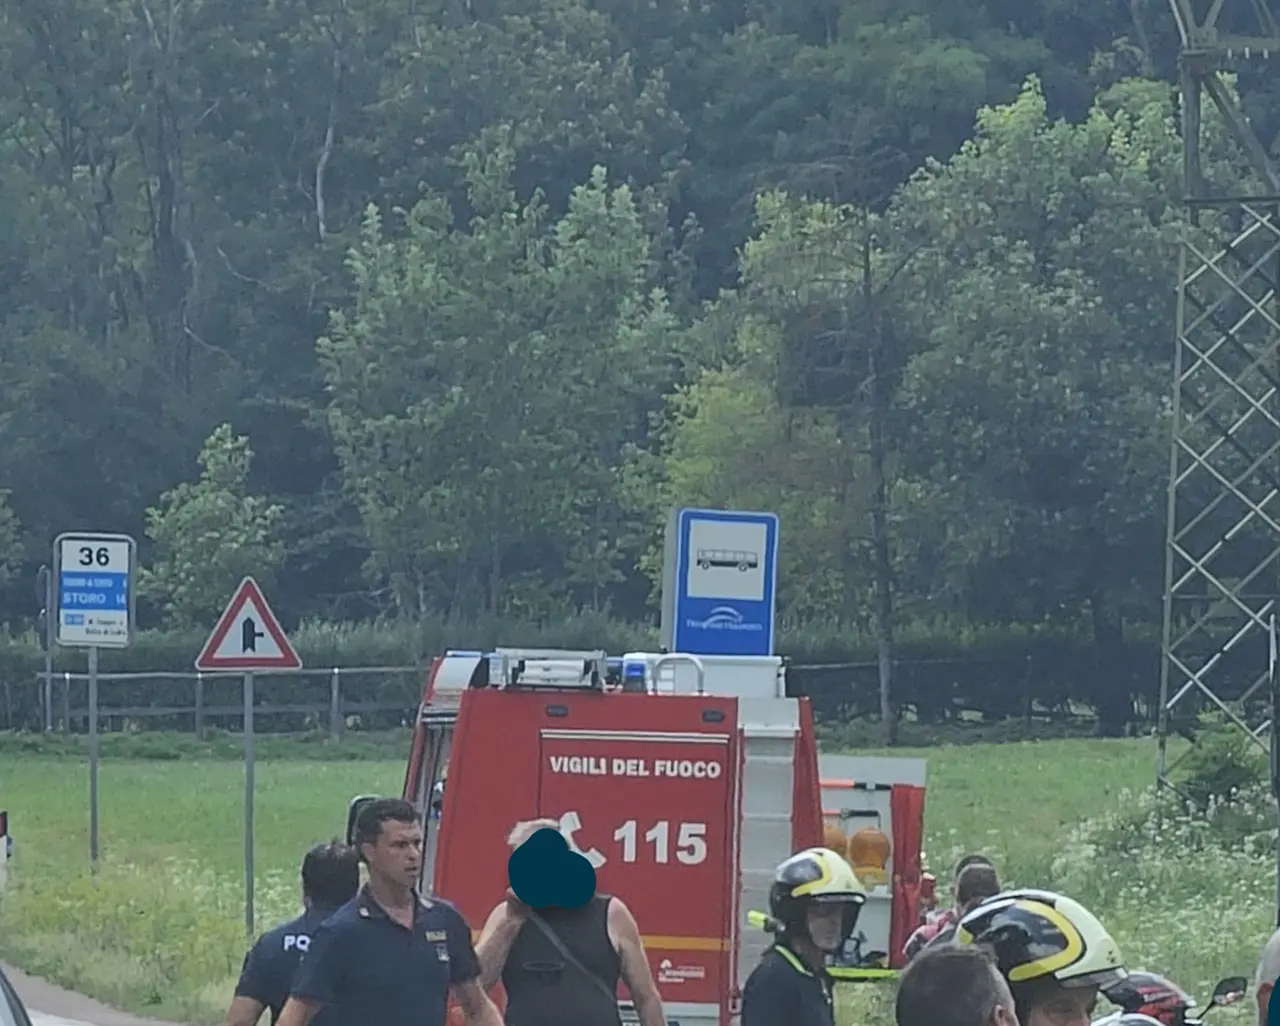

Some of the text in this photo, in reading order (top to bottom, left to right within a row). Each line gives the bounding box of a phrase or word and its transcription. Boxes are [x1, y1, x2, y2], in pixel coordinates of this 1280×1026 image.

[79, 547, 110, 566] 36
[63, 592, 106, 604] STORO
[549, 756, 721, 778] VIGILI DEL FUOCO
[613, 820, 708, 865] 115
